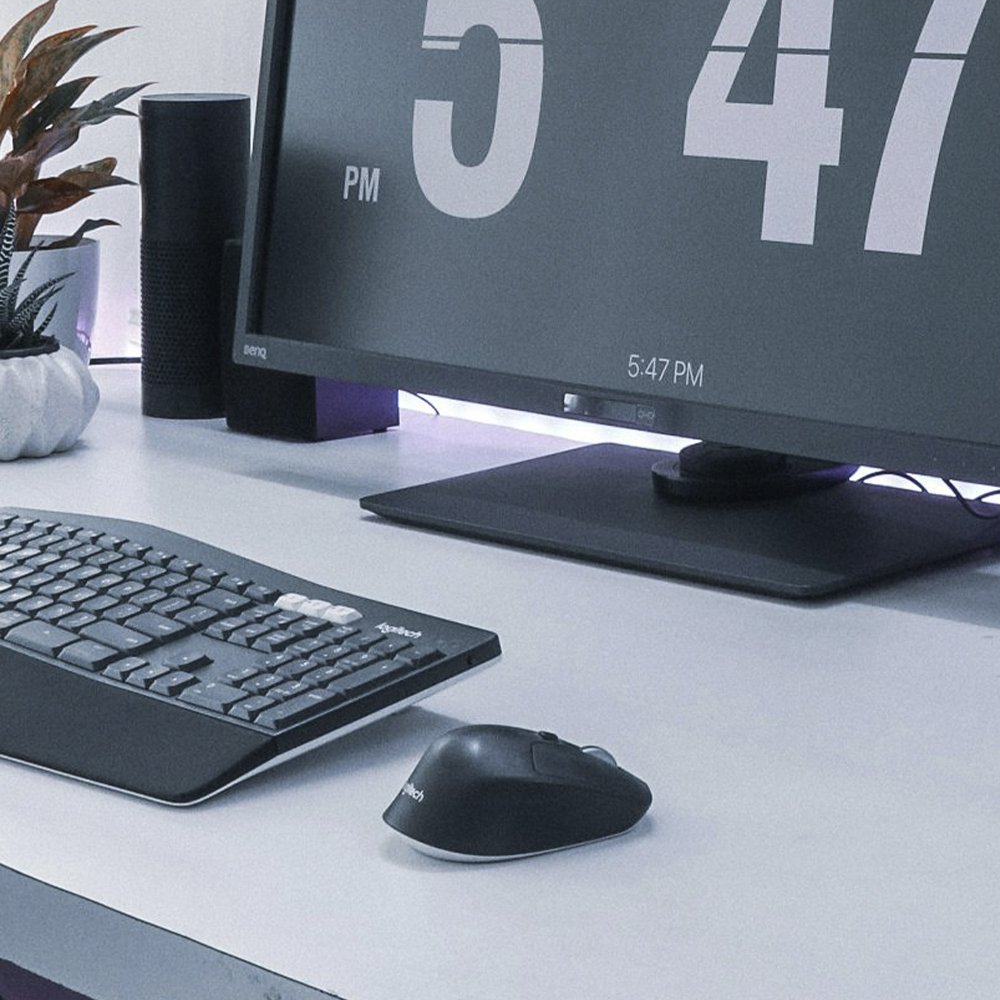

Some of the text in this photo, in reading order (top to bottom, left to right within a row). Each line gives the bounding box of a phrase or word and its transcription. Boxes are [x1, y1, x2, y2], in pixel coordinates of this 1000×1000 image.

[344, 166, 380, 202] PM
[628, 354, 703, 387] 5:47 PM
